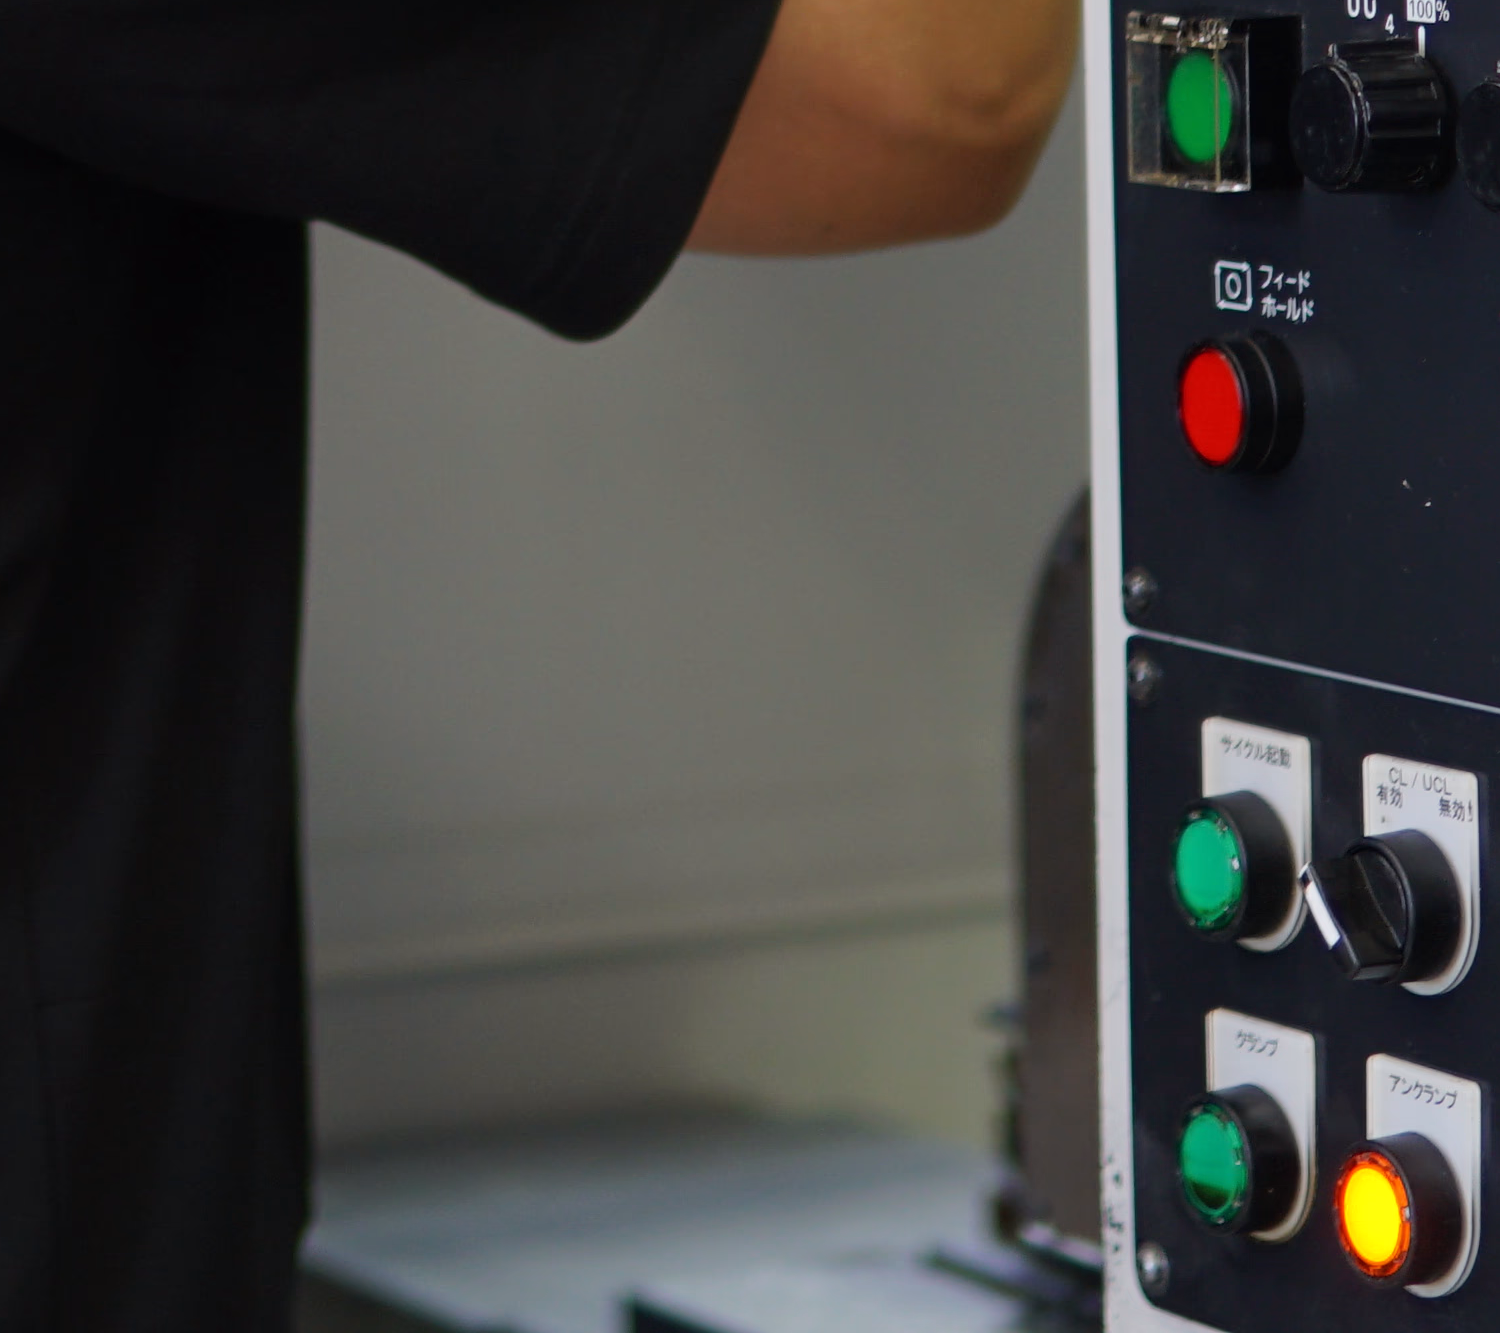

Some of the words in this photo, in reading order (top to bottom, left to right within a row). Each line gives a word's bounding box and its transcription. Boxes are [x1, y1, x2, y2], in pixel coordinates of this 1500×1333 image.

[1258, 265, 1311, 290] フィード
[1262, 297, 1314, 323] ホールド
[1222, 735, 1291, 768] サイクル起動
[1389, 767, 1407, 786] CL
[1422, 777, 1452, 796] UCL
[1376, 783, 1403, 808] 有効
[1388, 1074, 1457, 1109] アンクランプ
